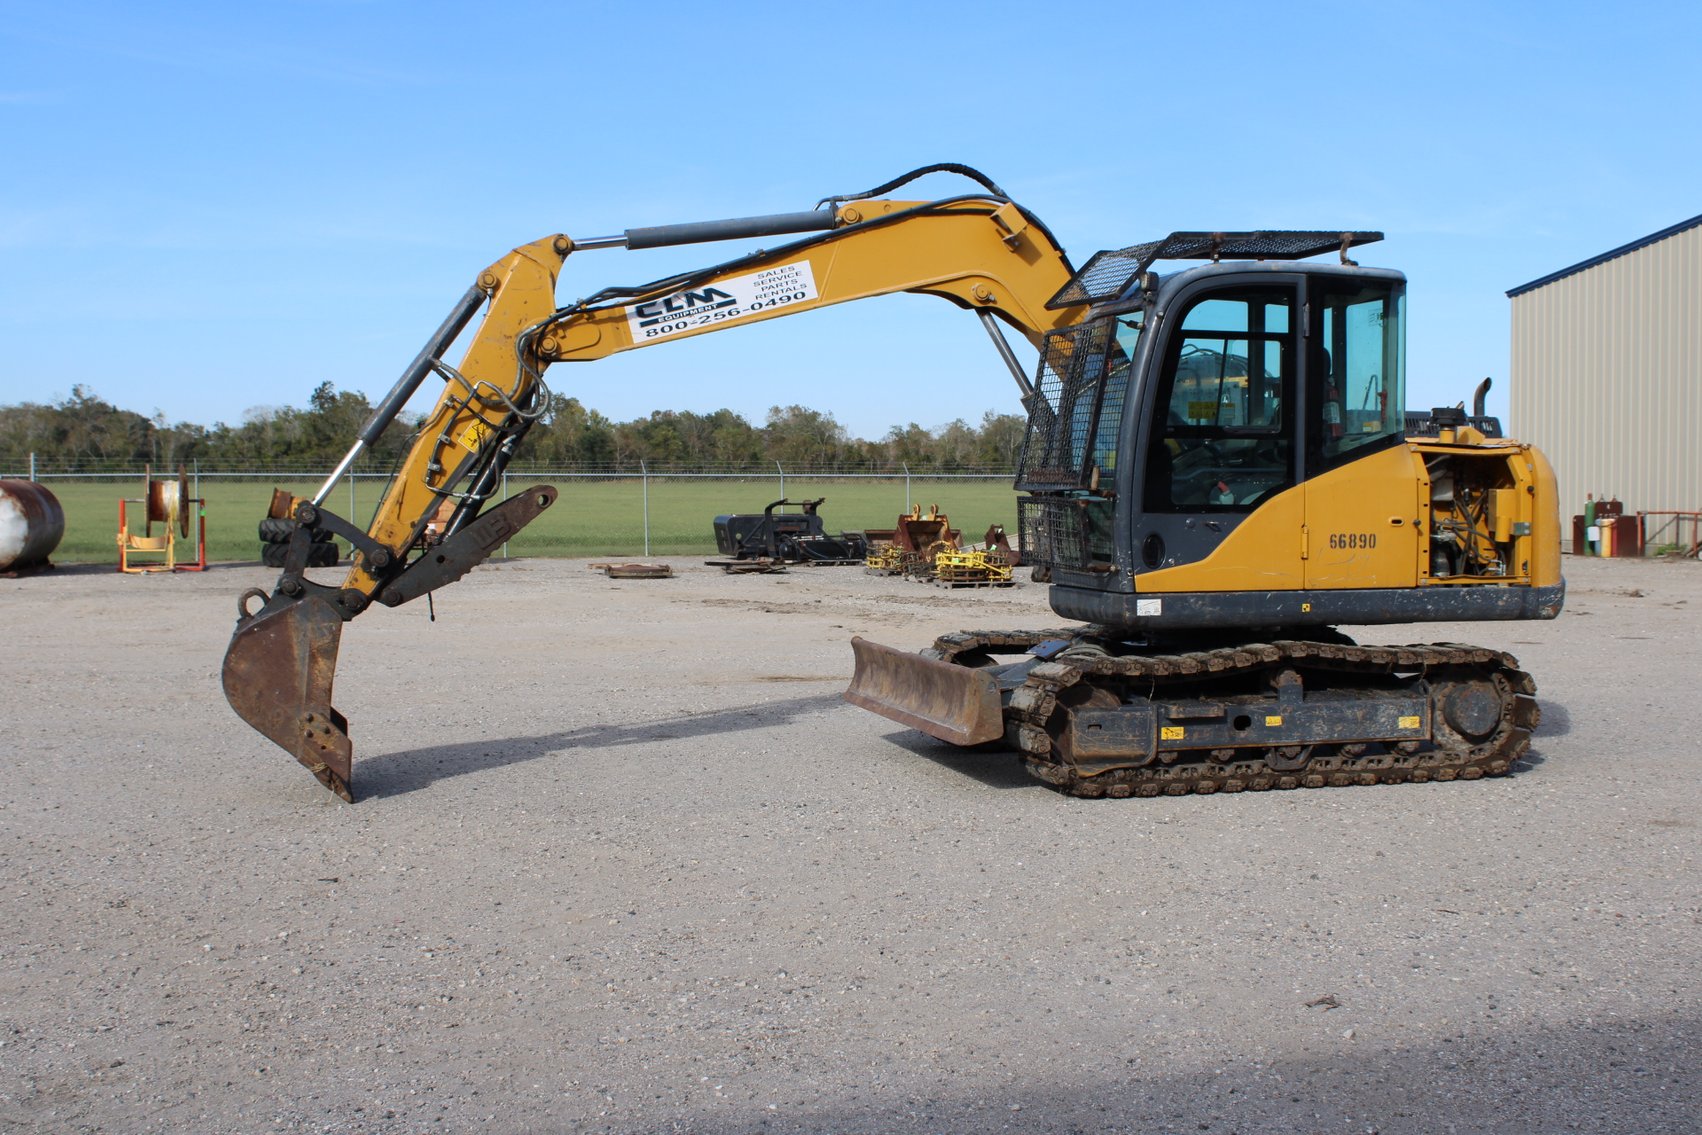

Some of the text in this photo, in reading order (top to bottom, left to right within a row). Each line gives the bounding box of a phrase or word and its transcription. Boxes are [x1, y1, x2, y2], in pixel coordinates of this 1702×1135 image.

[753, 271, 802, 287] SERVICE
[757, 266, 795, 279] SALES
[755, 283, 807, 300] RENTALS
[761, 279, 798, 292] PARTS
[645, 291, 806, 337] 800-256-0490
[658, 303, 718, 323] EQUIPMENT
[1329, 533, 1376, 549] 66890
